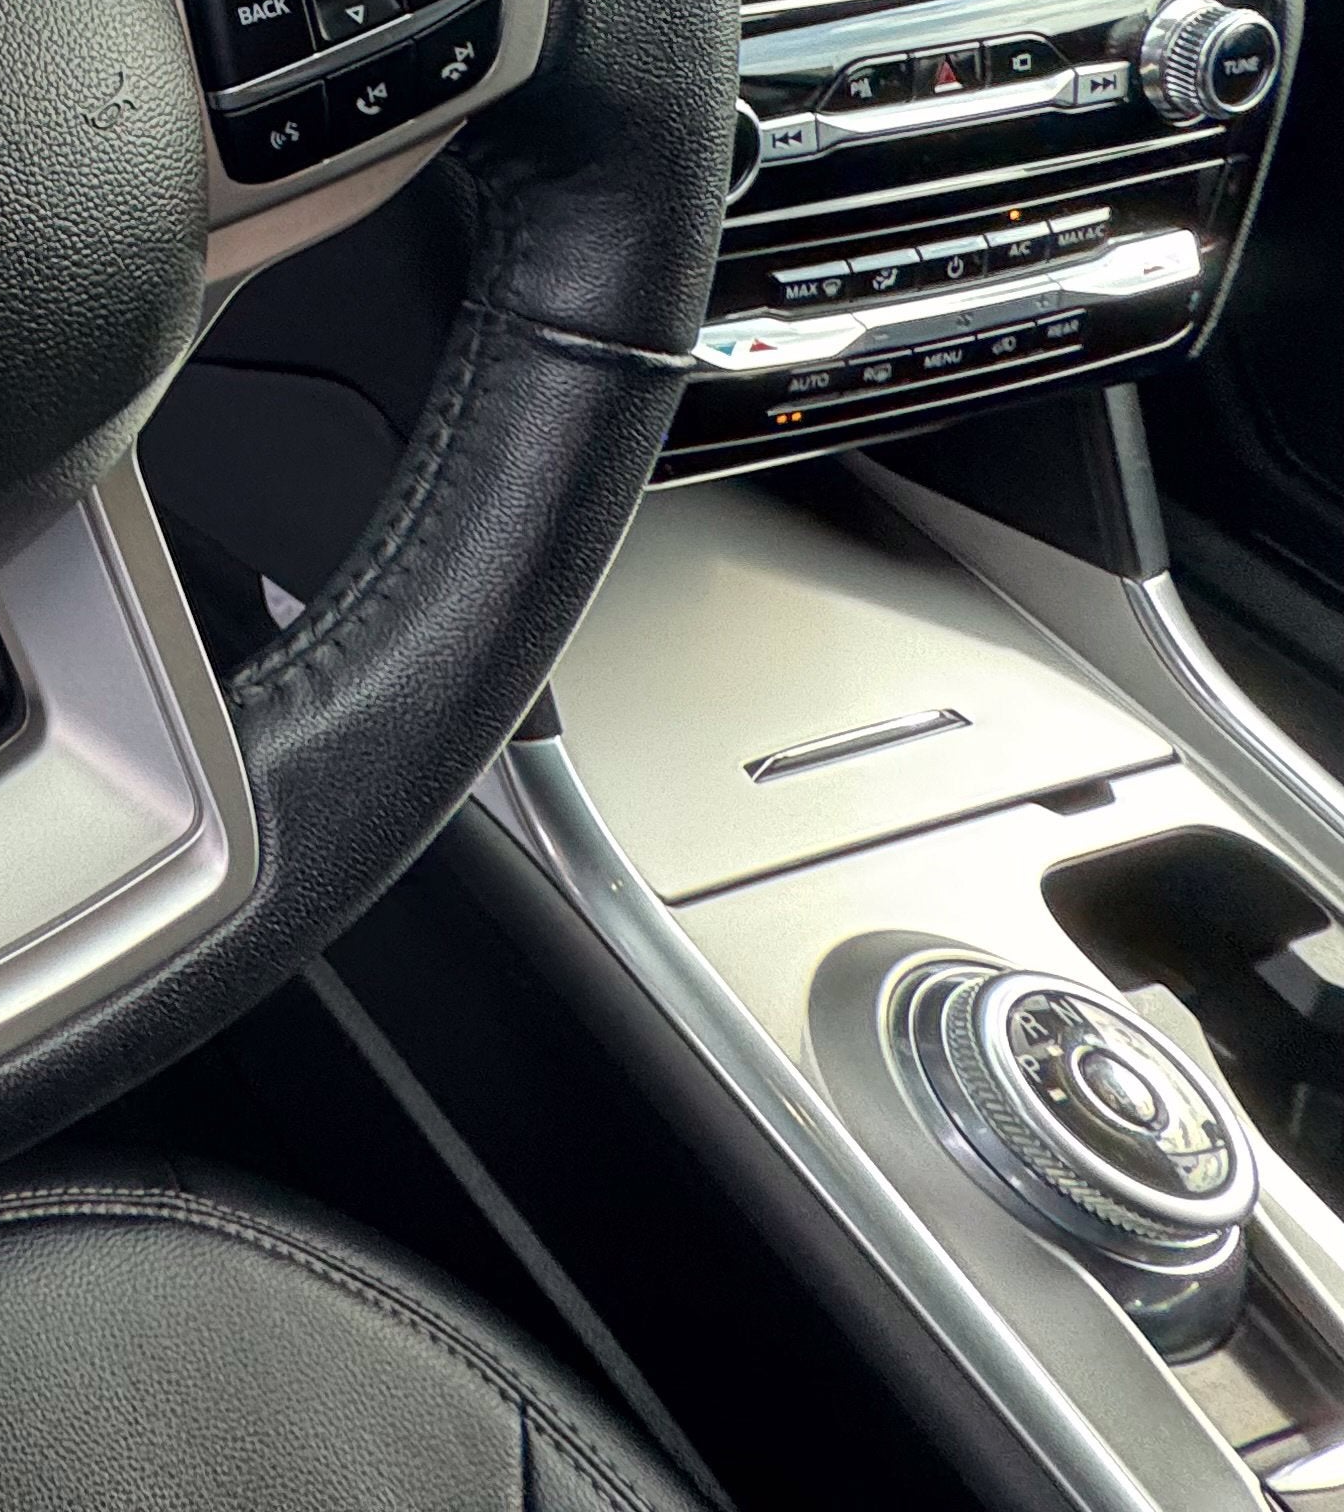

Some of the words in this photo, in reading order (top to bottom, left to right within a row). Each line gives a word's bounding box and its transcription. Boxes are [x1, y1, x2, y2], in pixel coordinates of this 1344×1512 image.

[1224, 56, 1260, 76] TUNE
[1009, 242, 1031, 257] A/C
[786, 282, 818, 300] MAX
[1047, 320, 1080, 338] REAR
[924, 350, 963, 369] MENU
[790, 373, 830, 392] AUTO
[1018, 1011, 1048, 1039] R
[1016, 1054, 1041, 1083] P
